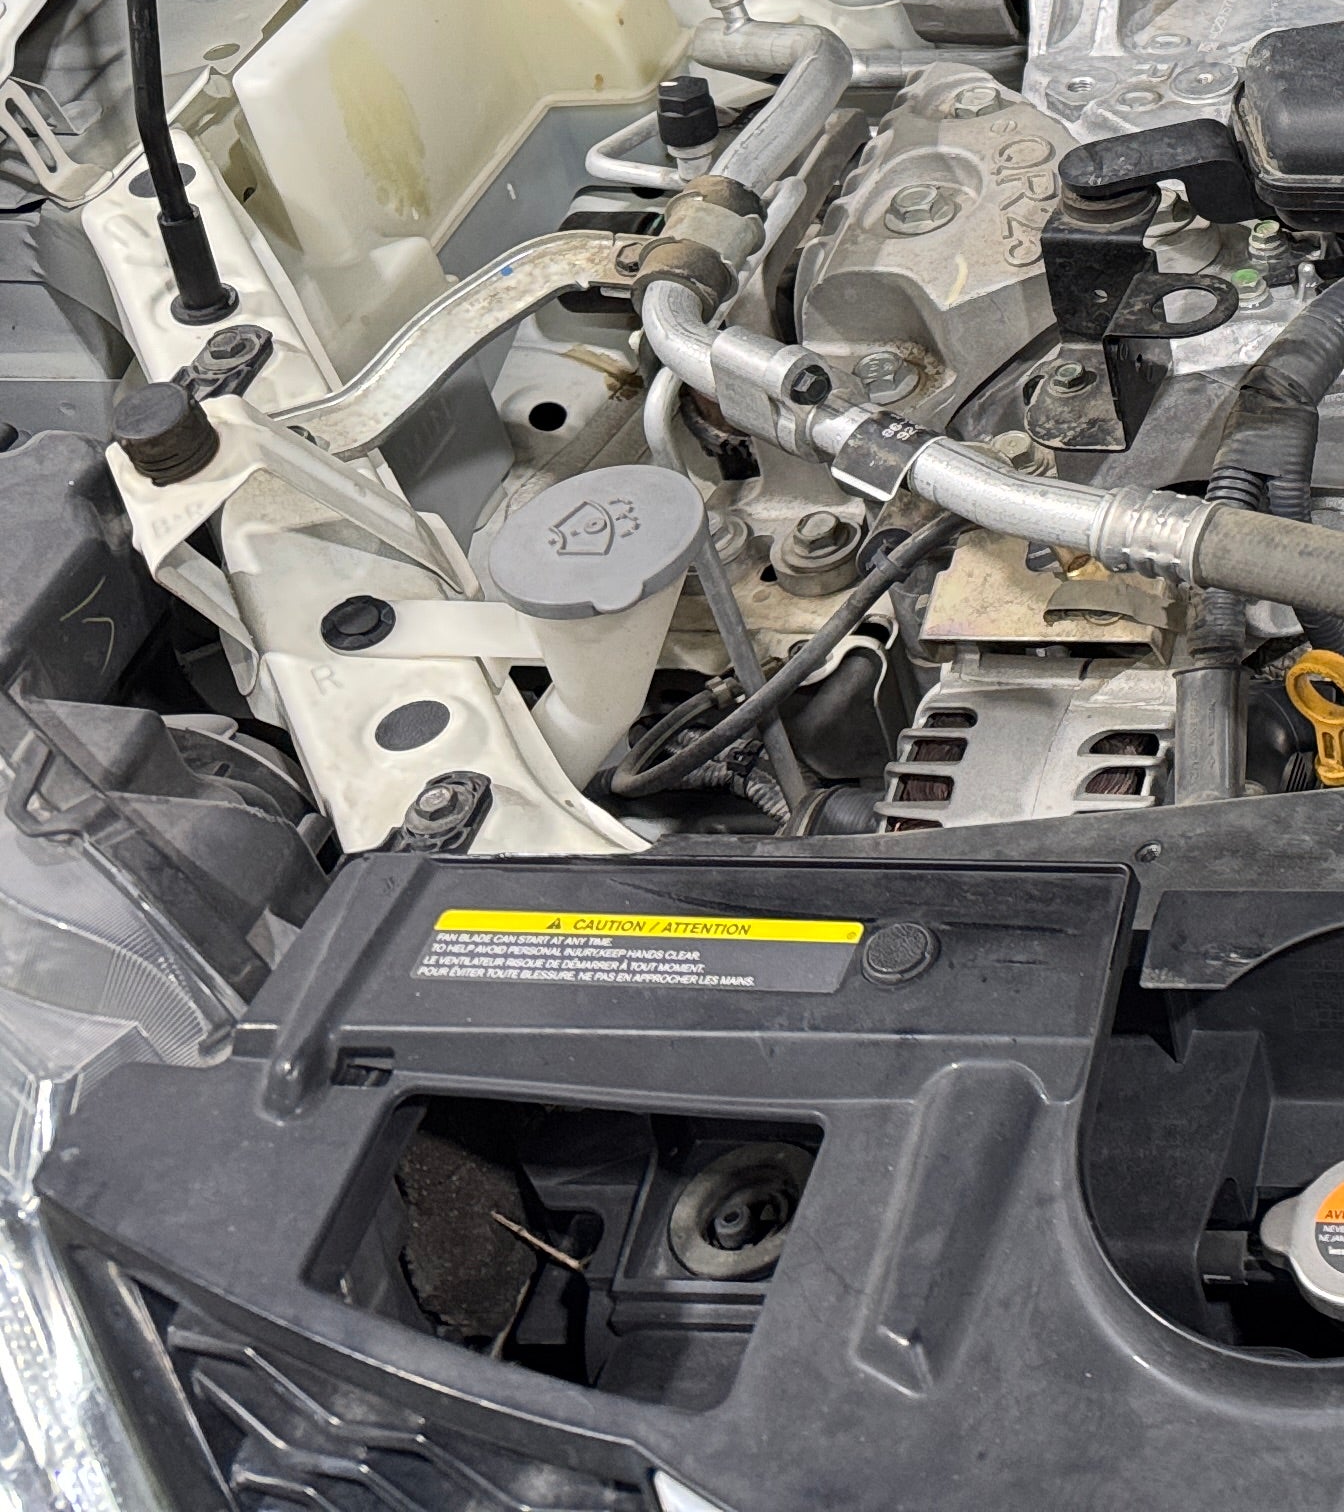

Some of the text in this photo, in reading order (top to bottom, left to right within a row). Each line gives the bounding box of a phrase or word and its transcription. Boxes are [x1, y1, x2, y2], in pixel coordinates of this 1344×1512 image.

[310, 664, 343, 696] R
[573, 918, 647, 934] CAUTION
[661, 920, 751, 937] ATTENTION
[436, 933, 458, 942] FAN
[458, 933, 493, 943] BLADE
[494, 934, 516, 944] CAN
[517, 934, 549, 944] START
[550, 935, 564, 945] AT
[564, 936, 587, 945] ANY
[431, 943, 447, 952] TO
[447, 944, 475, 953] HELP
[474, 944, 507, 954] AVOID
[507, 945, 562, 956] PERSONAL
[626, 949, 664, 959] HANDS
[422, 955, 437, 965] LE
[438, 956, 505, 967] VENTILATEUR
[505, 958, 544, 968] RISQUE
[545, 959, 562, 969] DE
[629, 961, 658, 972] TOUT
[416, 966, 449, 976] POUR
[486, 968, 520, 978] TOUTE
[578, 971, 594, 981] NE
[593, 971, 616, 982] PAS
[616, 972, 632, 982] EN
[632, 973, 698, 984] APPROCHER
[698, 975, 719, 985] LES
[1318, 1234, 1329, 1242] NE
